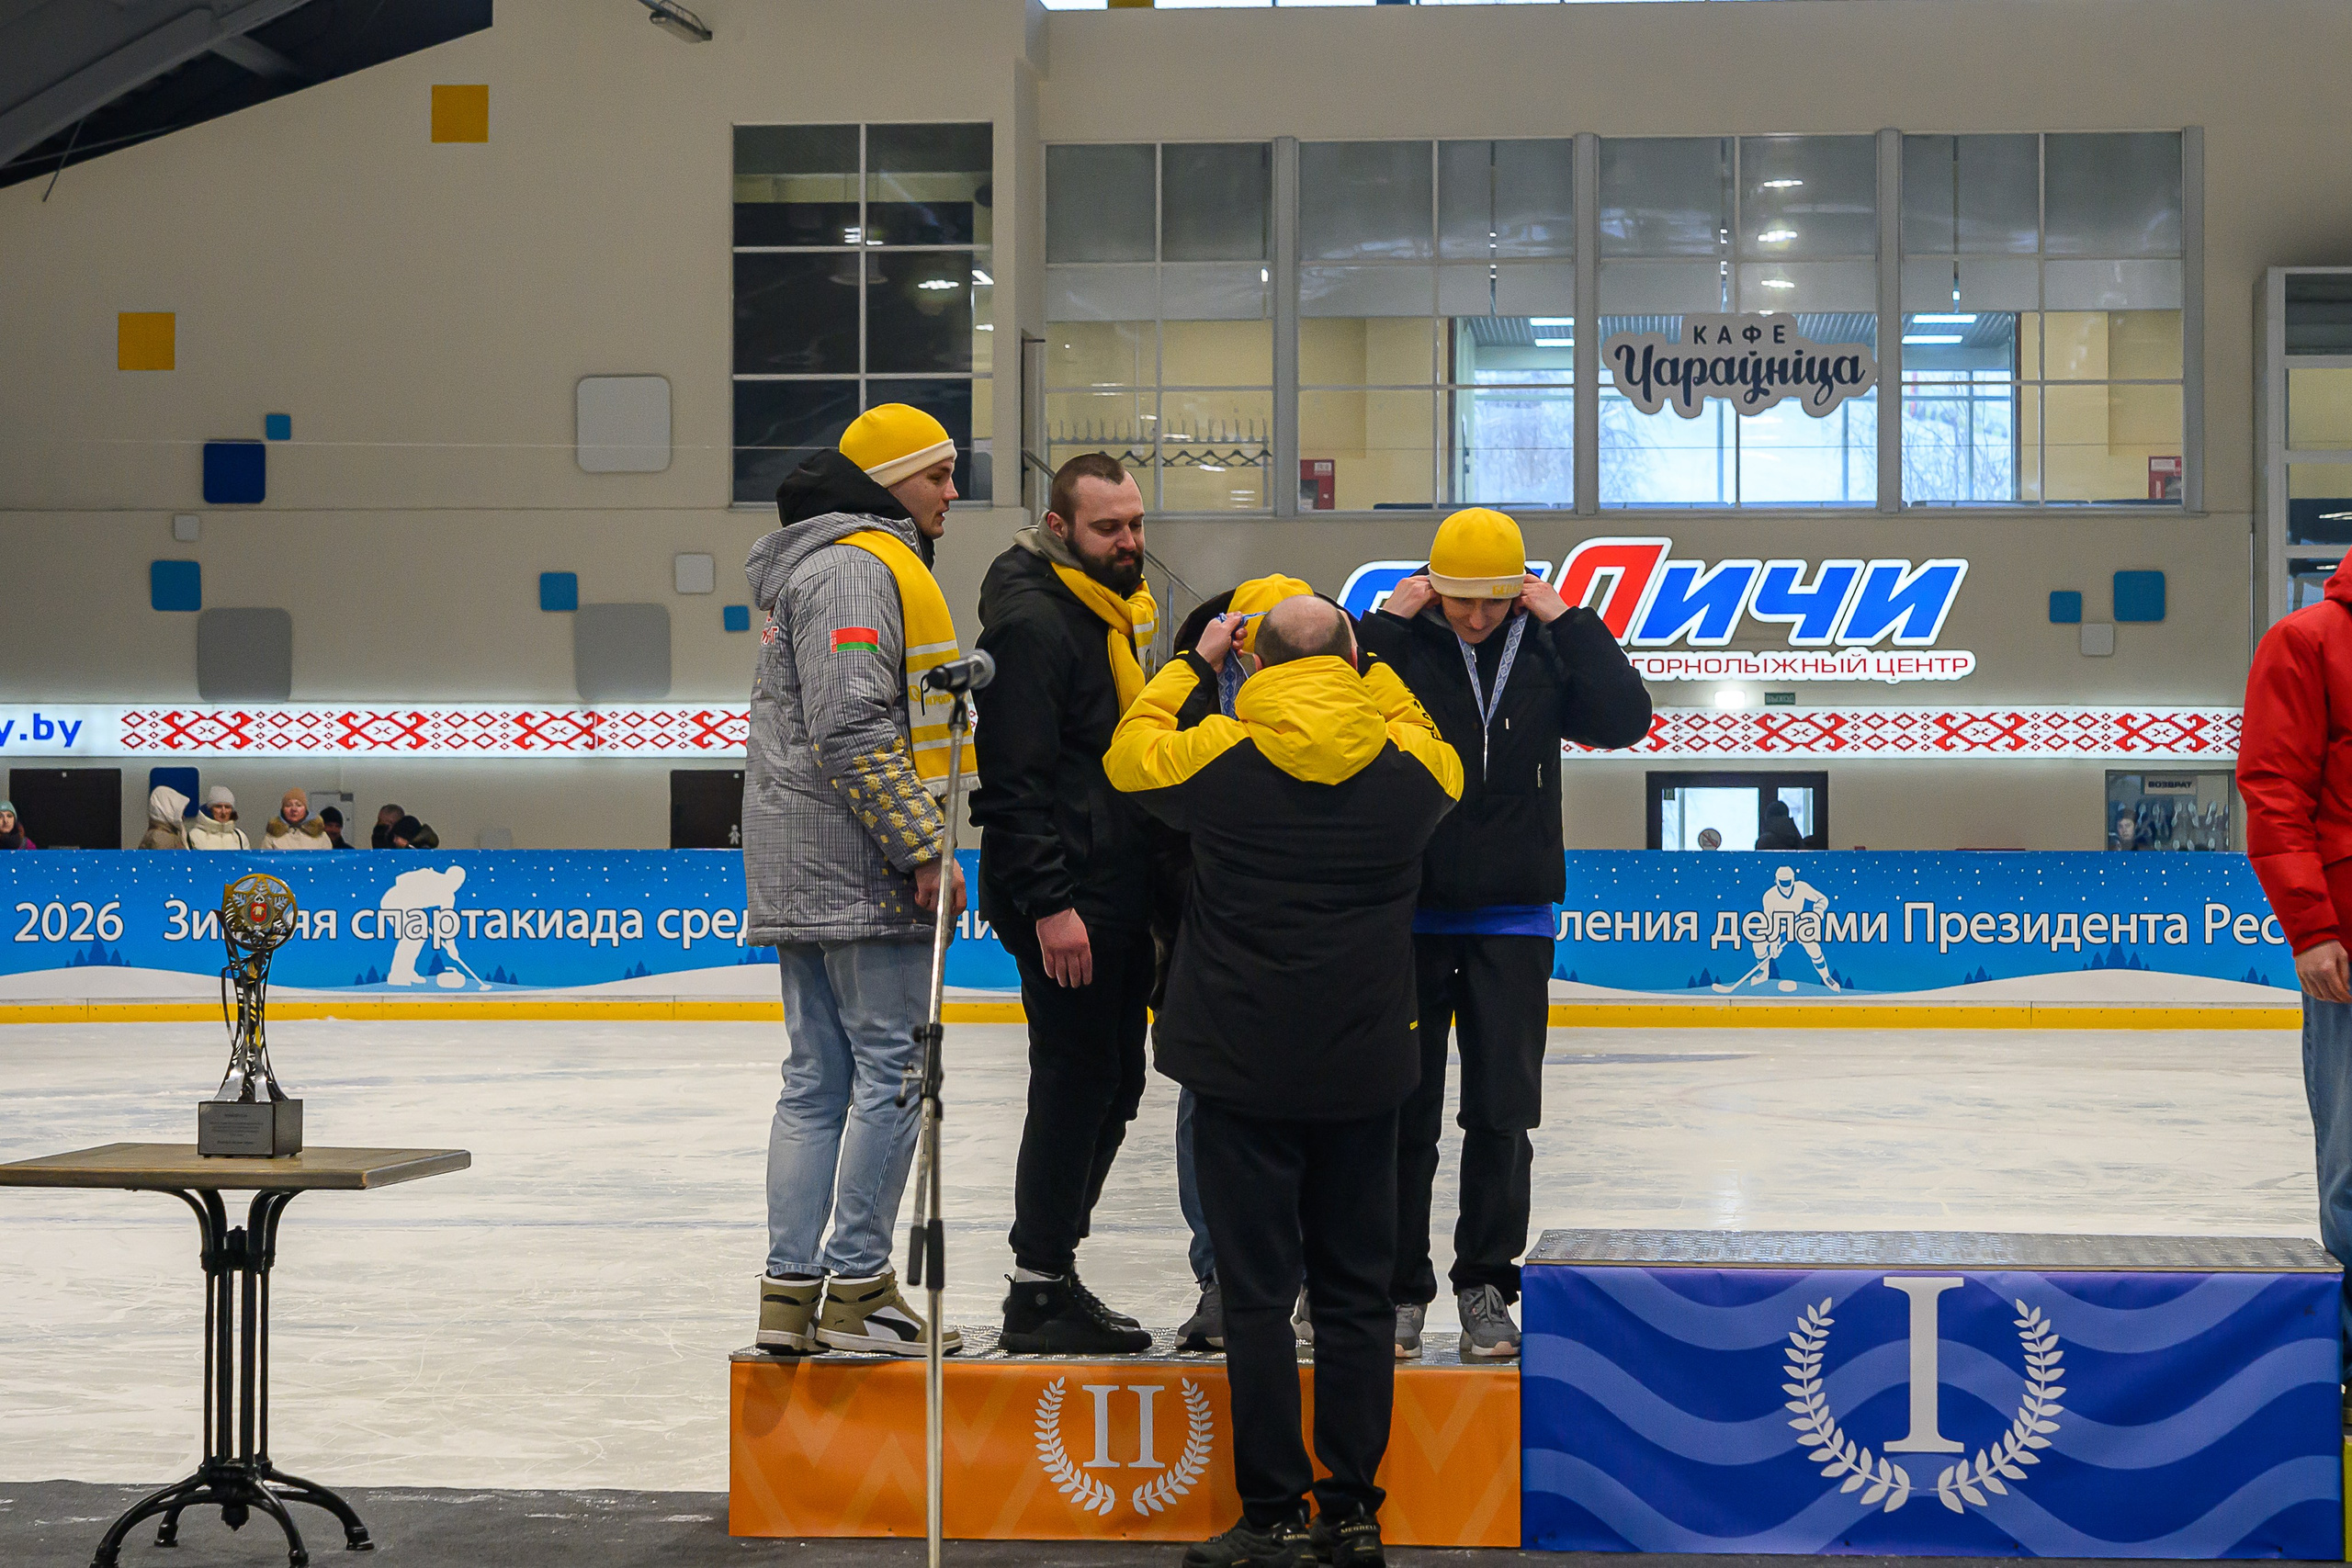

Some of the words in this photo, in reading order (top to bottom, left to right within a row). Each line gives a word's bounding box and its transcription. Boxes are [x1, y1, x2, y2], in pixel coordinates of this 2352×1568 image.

[1693, 324, 1785, 344] КАФЕ
[1876, 658, 1969, 676] ЦЕНТР
[14, 901, 124, 942] 2026
[351, 908, 643, 950] спартакиада
[1711, 910, 1888, 950] делами
[1903, 901, 2188, 953] Президента
[1883, 1275, 1964, 1453] I
[1082, 1383, 1166, 1469] II
[1340, 1524, 1377, 1534] MERRELL
